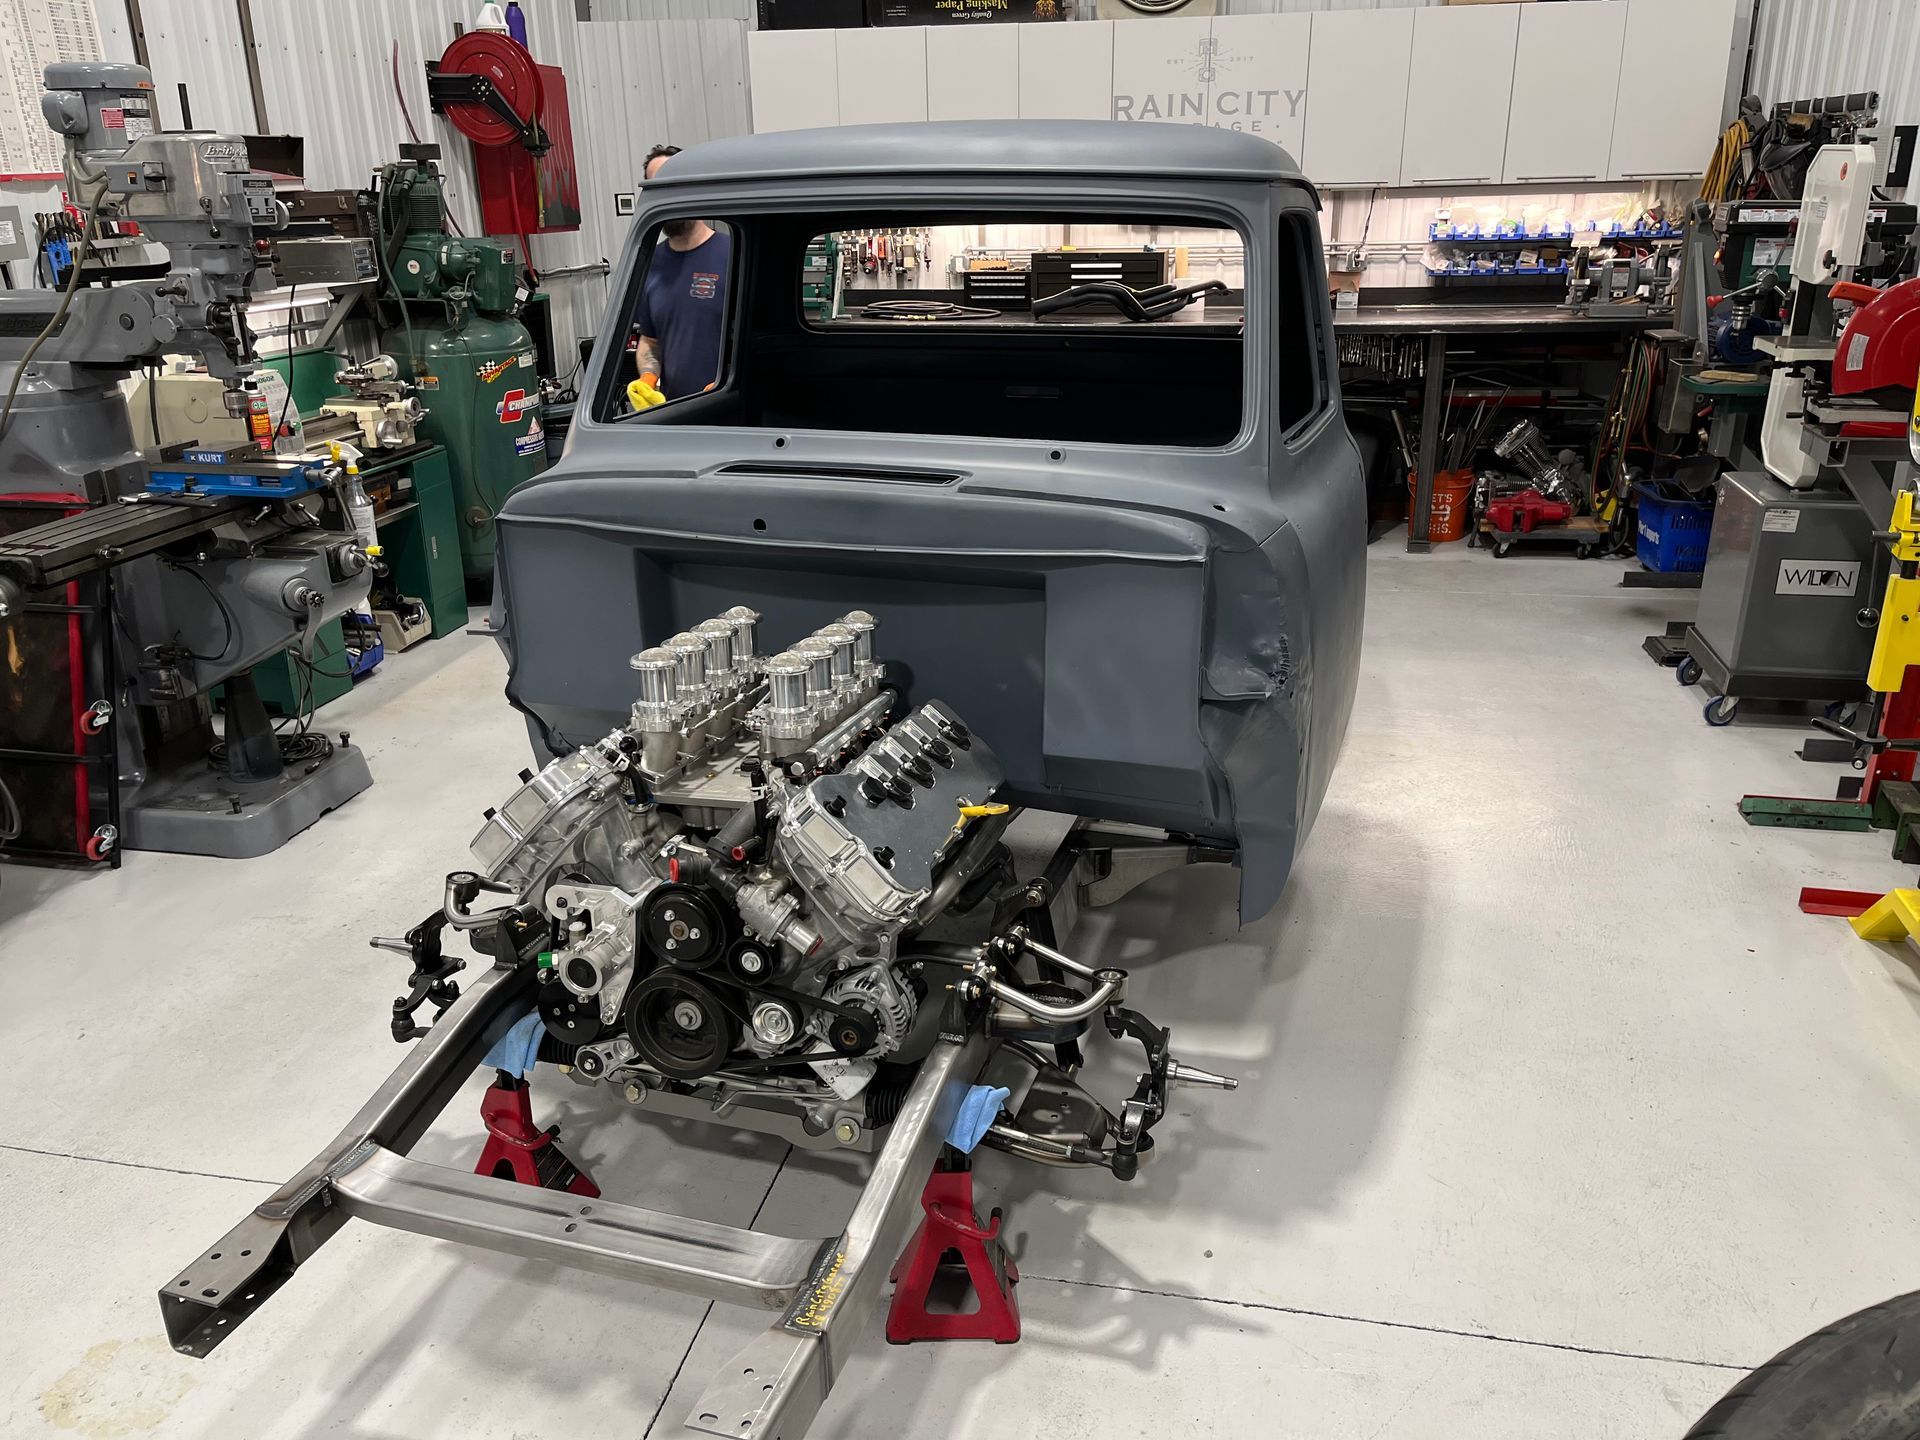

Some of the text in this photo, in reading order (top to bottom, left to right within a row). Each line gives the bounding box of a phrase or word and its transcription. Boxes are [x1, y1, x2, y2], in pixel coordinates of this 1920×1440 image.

[935, 0, 1008, 10] Masking Paper
[1113, 89, 1305, 121] RAIN CITY
[198, 453, 222, 463] KURT
[1432, 493, 1453, 503] ET'S
[1784, 568, 1854, 587] WILTON
